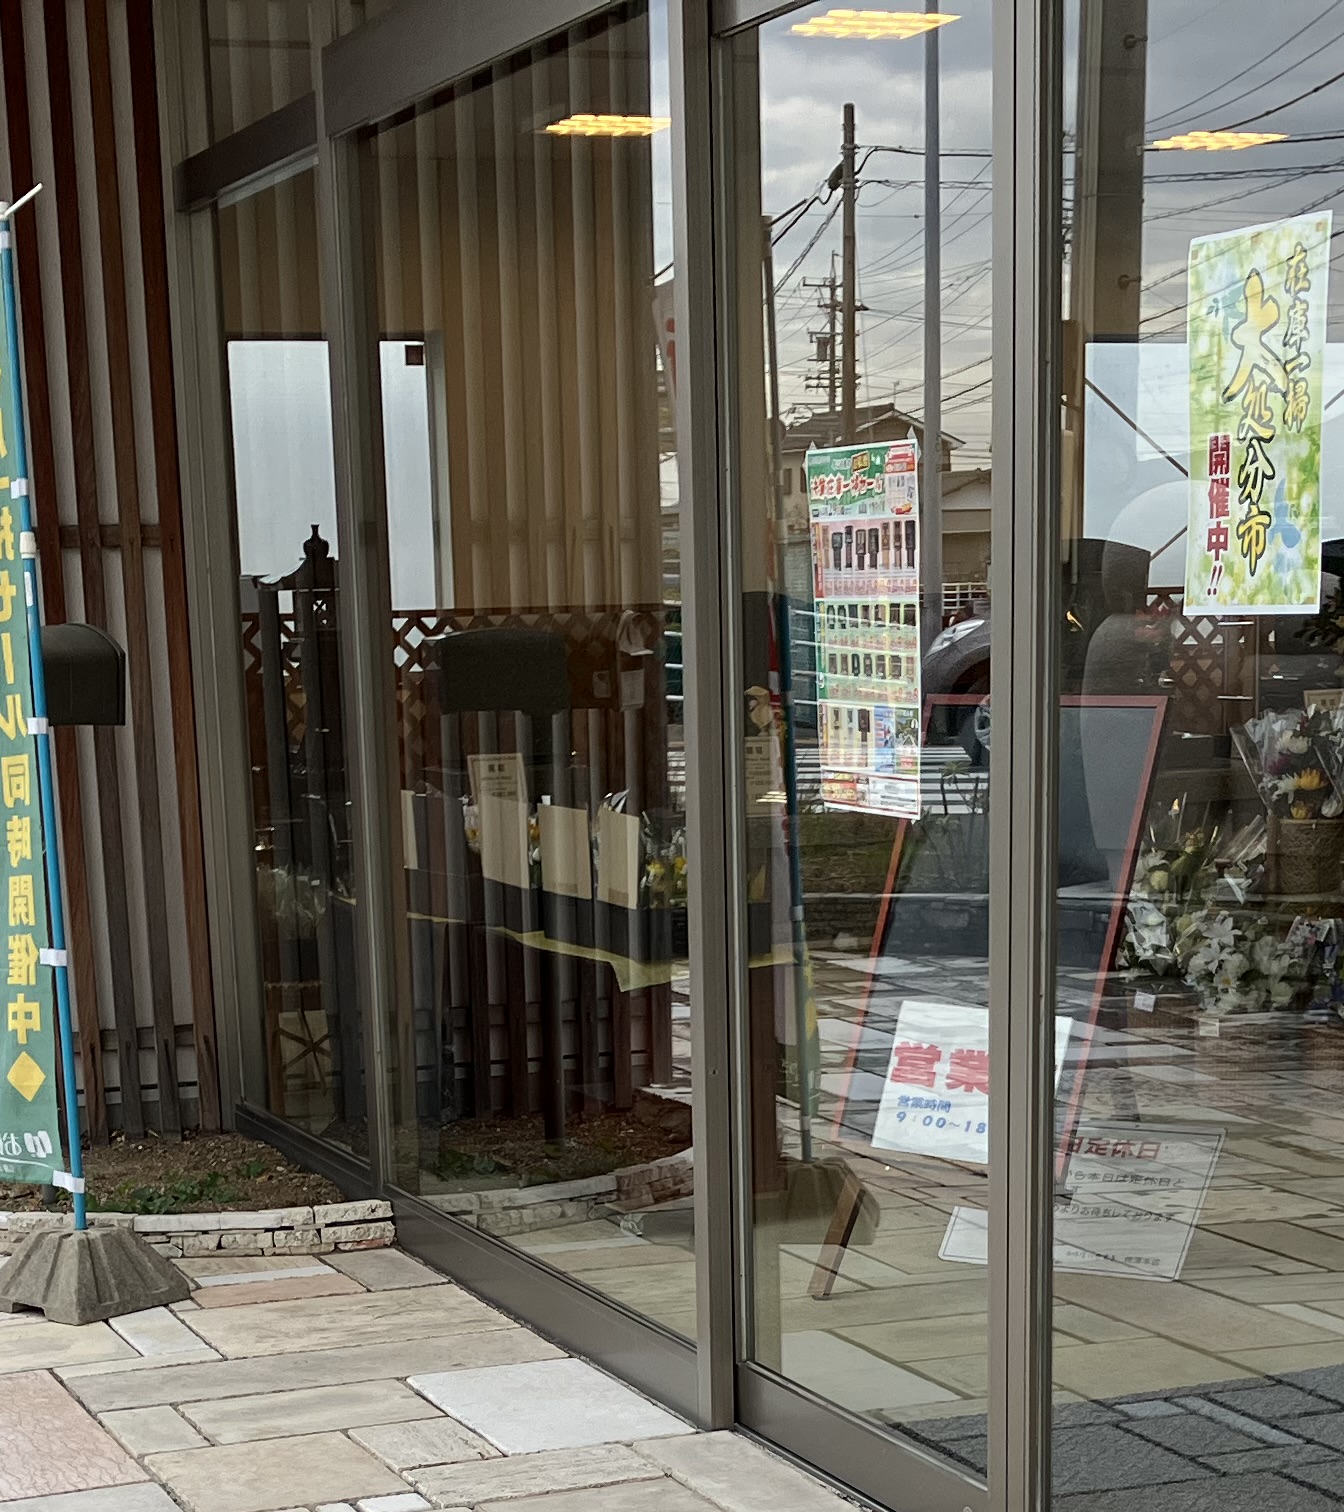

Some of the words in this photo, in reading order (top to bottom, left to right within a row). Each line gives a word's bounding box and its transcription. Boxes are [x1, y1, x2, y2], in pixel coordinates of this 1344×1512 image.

[1283, 242, 1312, 434] 在庫一掃
[1222, 268, 1289, 577] 大処分市
[889, 1041, 990, 1096] 営業
[1069, 1169, 1185, 1188] ら本日は定休日と
